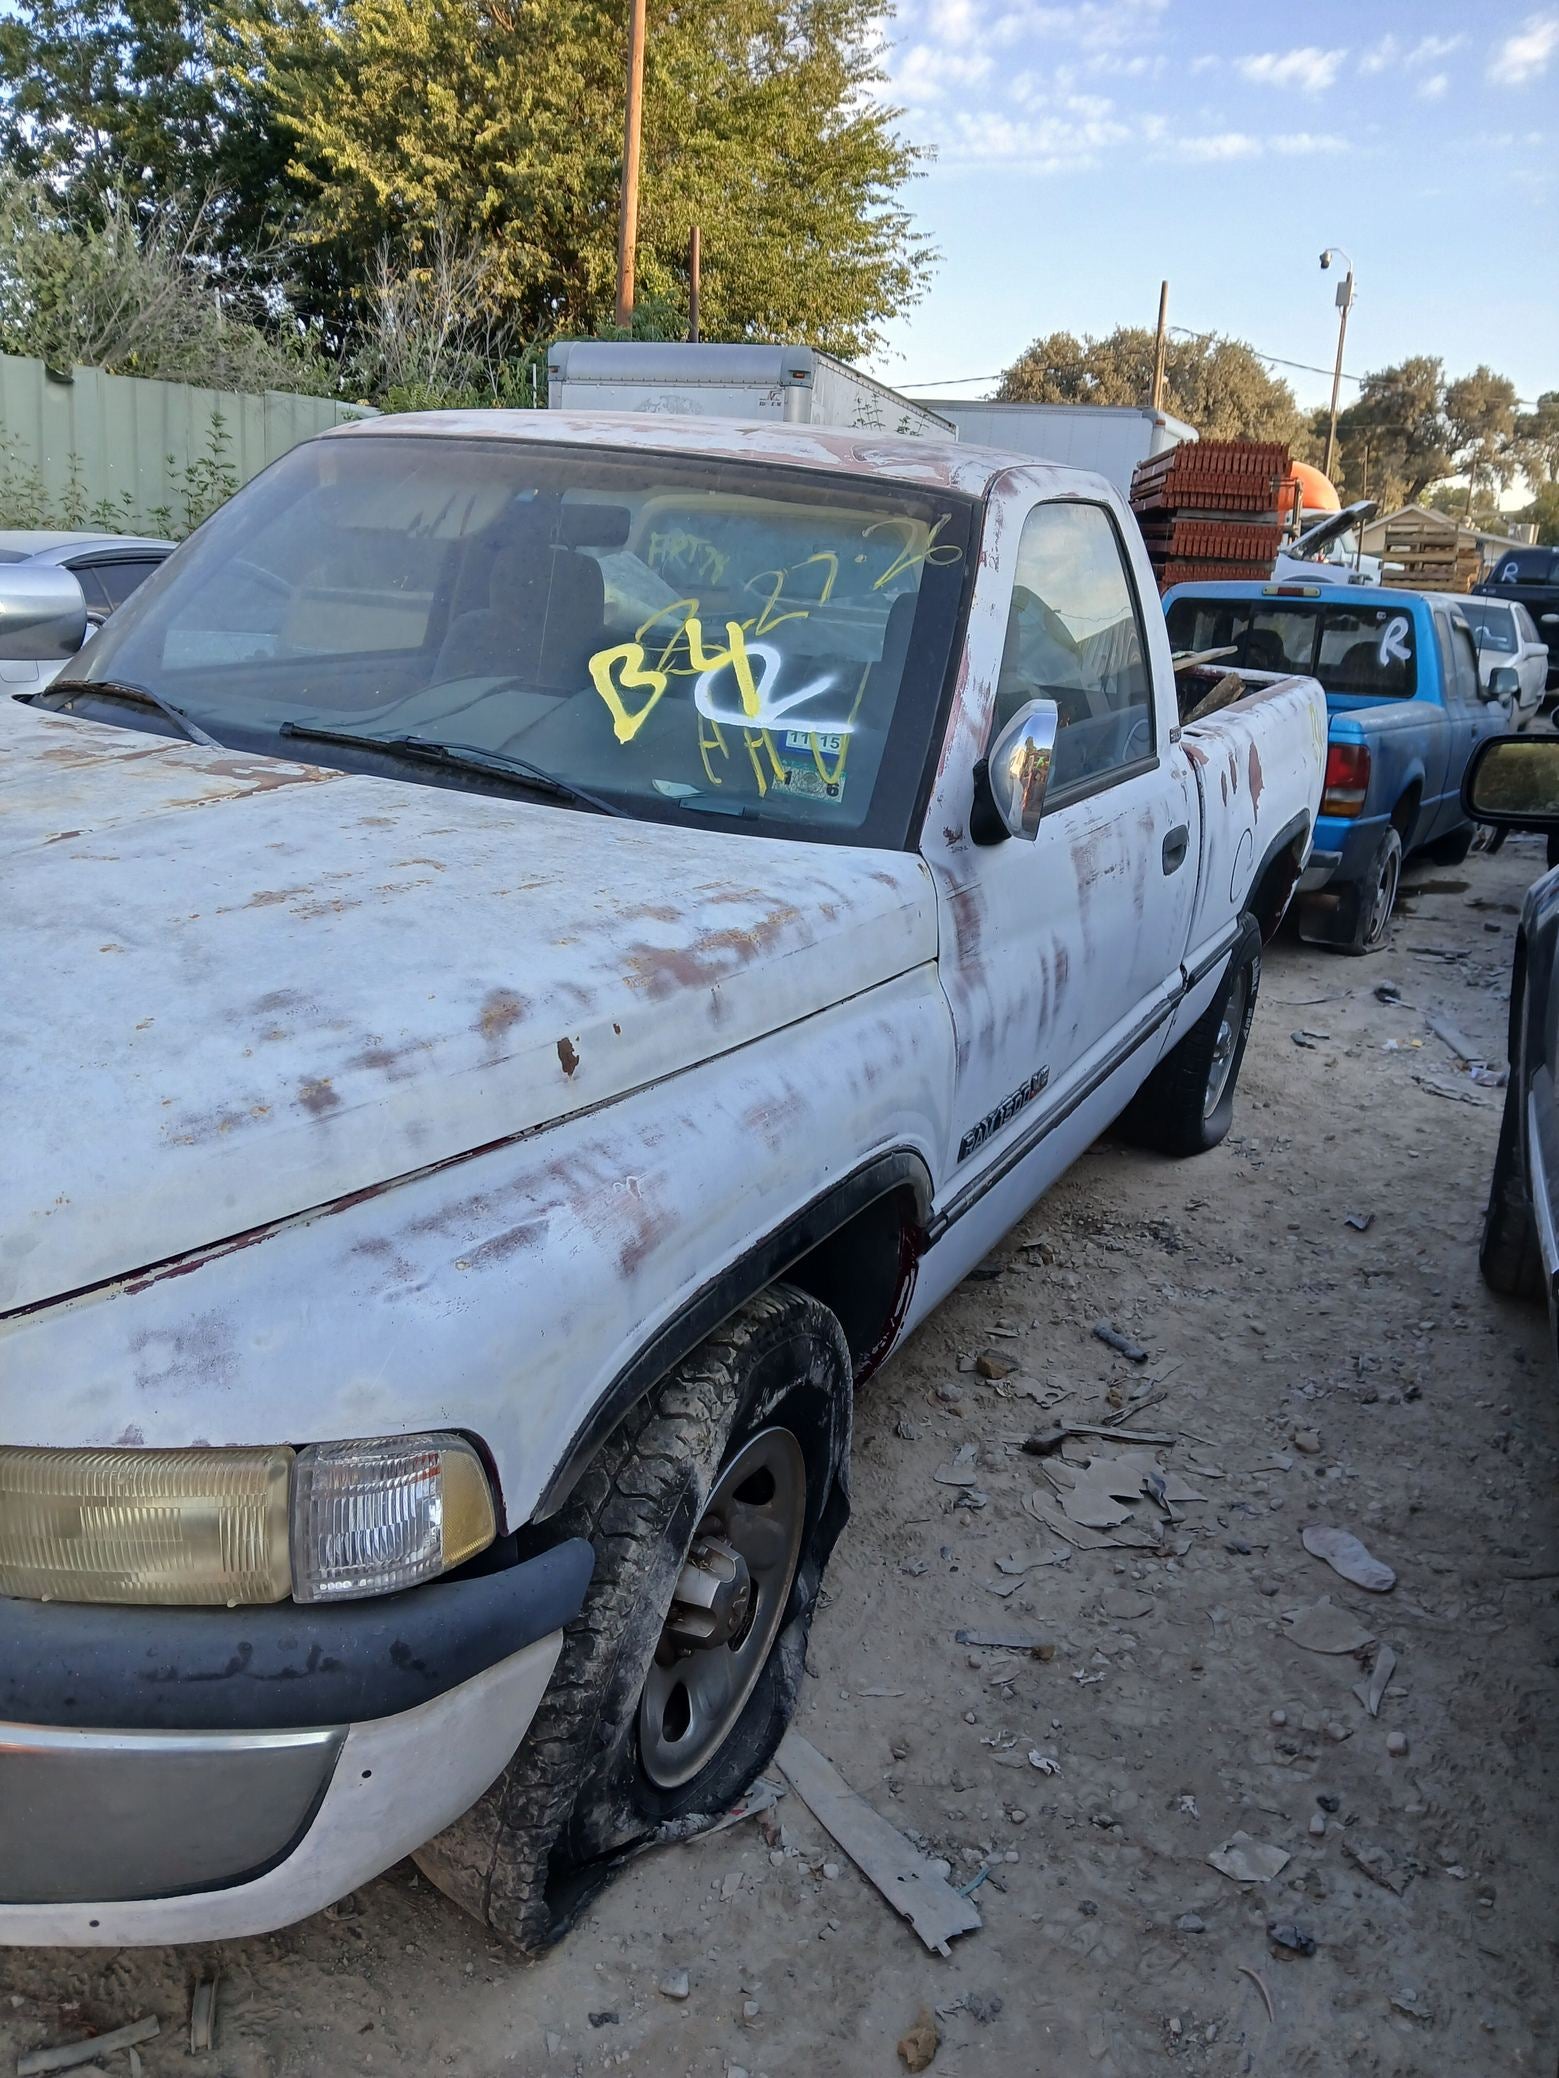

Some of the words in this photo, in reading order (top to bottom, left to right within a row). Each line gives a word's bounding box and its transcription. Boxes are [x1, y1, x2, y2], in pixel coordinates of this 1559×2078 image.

[1501, 562, 1519, 583] R
[1380, 616, 1412, 667] R
[820, 735, 840, 749] 15
